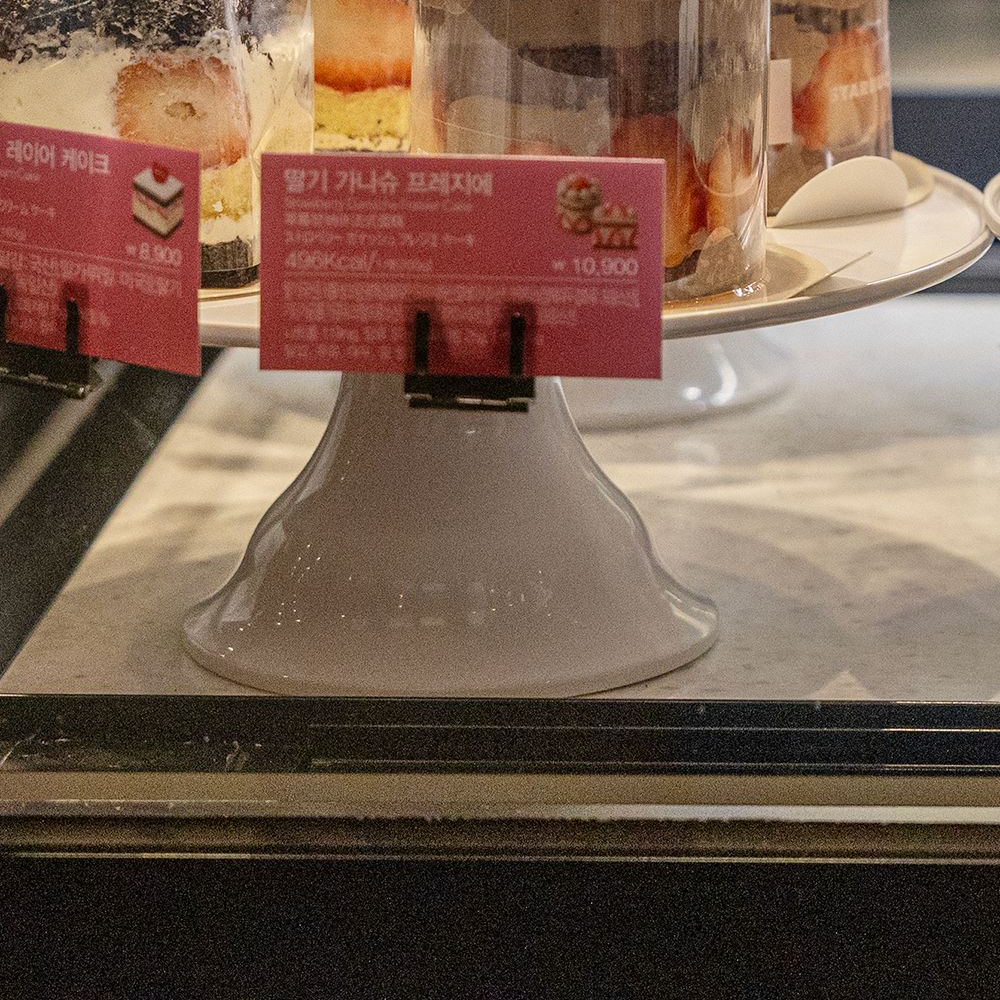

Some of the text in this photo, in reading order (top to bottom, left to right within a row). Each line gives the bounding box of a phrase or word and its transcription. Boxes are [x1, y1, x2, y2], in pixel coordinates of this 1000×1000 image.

[6, 139, 111, 176] 레이어 케이크
[283, 167, 493, 197] 딸기 가나슈 프레지에
[572, 256, 640, 278] 10,900
